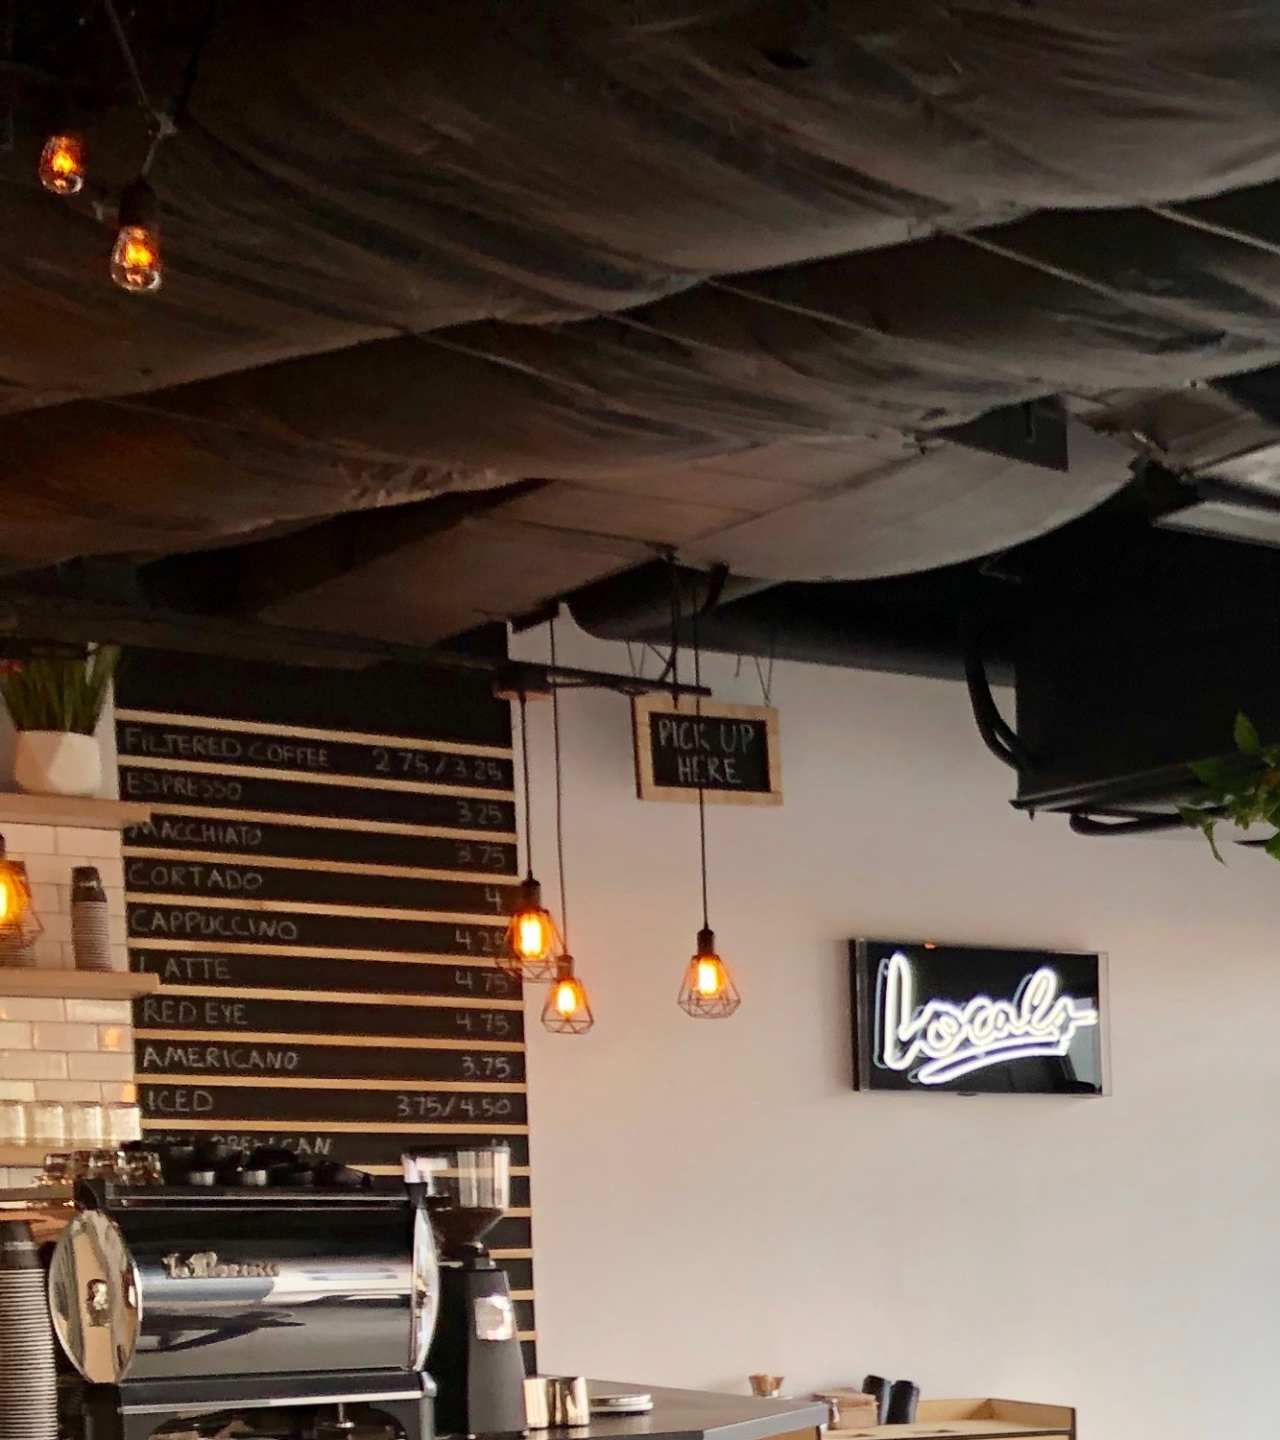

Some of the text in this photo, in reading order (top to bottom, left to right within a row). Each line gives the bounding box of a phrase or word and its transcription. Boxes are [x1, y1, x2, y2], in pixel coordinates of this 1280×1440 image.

[124, 726, 241, 757] FILTERED
[249, 741, 331, 767] COFFEE
[658, 719, 755, 754] PICK UP
[126, 771, 242, 799] ESPRESSO
[677, 755, 742, 784] HERE
[128, 862, 502, 912] CORTADO 4
[131, 908, 298, 940] CAPPUCCINO
[143, 1000, 197, 1024] RED
[205, 1002, 249, 1025] EYE
[143, 1046, 511, 1078] AMERICANO 3.75
[148, 1089, 214, 1112] ICED
